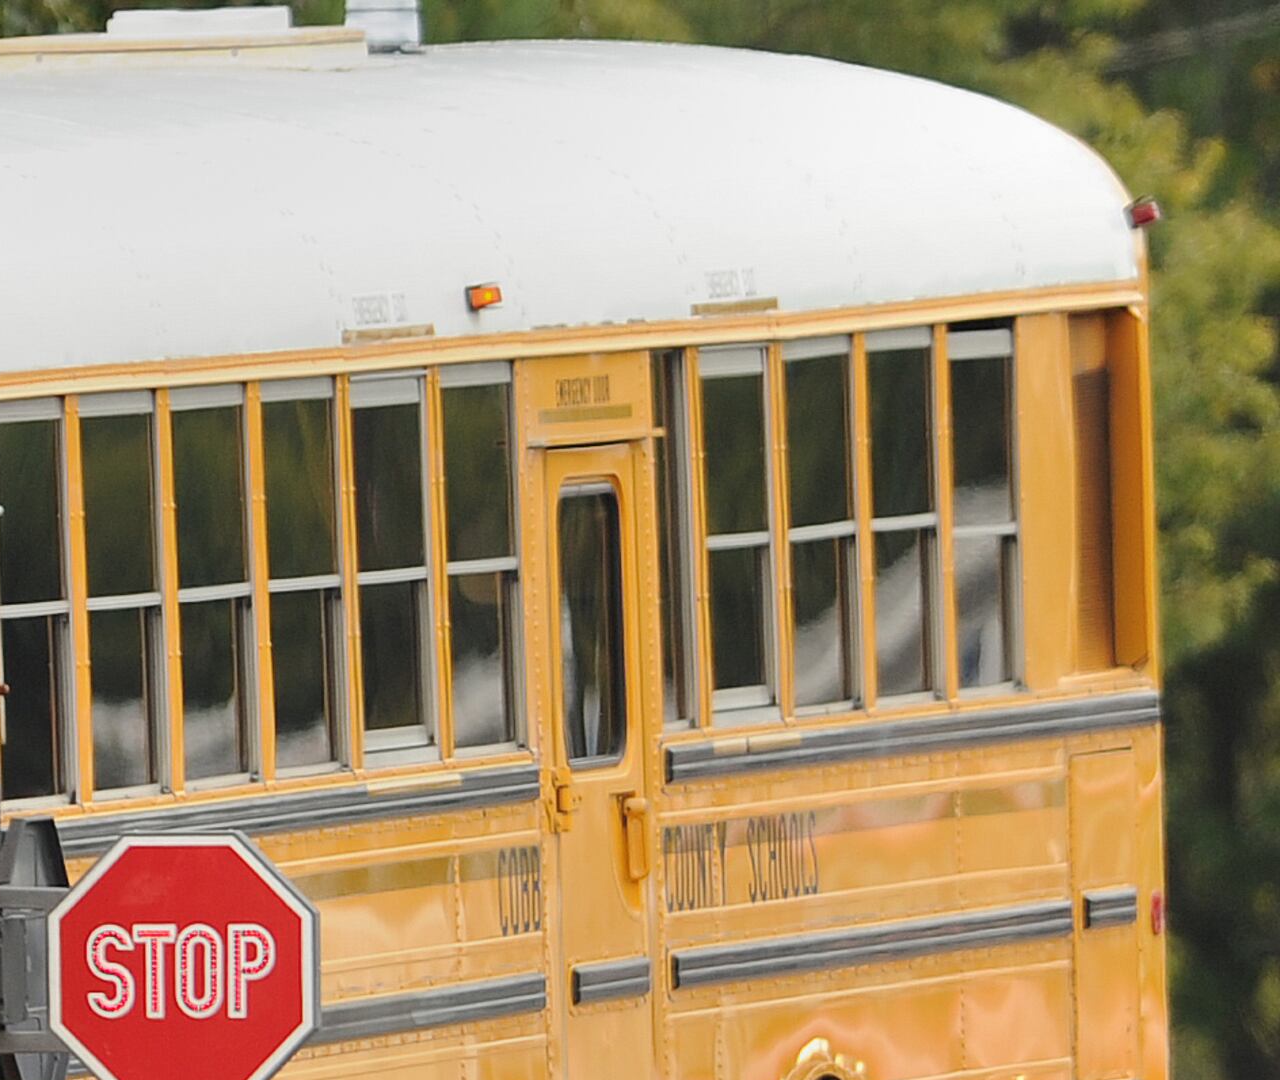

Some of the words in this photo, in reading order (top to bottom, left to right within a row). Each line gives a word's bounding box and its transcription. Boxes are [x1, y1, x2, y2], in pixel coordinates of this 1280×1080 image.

[498, 846, 541, 937] COBB
[663, 821, 728, 913] COUNTY
[746, 810, 820, 903] SCHOOLS
[86, 923, 276, 1020] STOP
